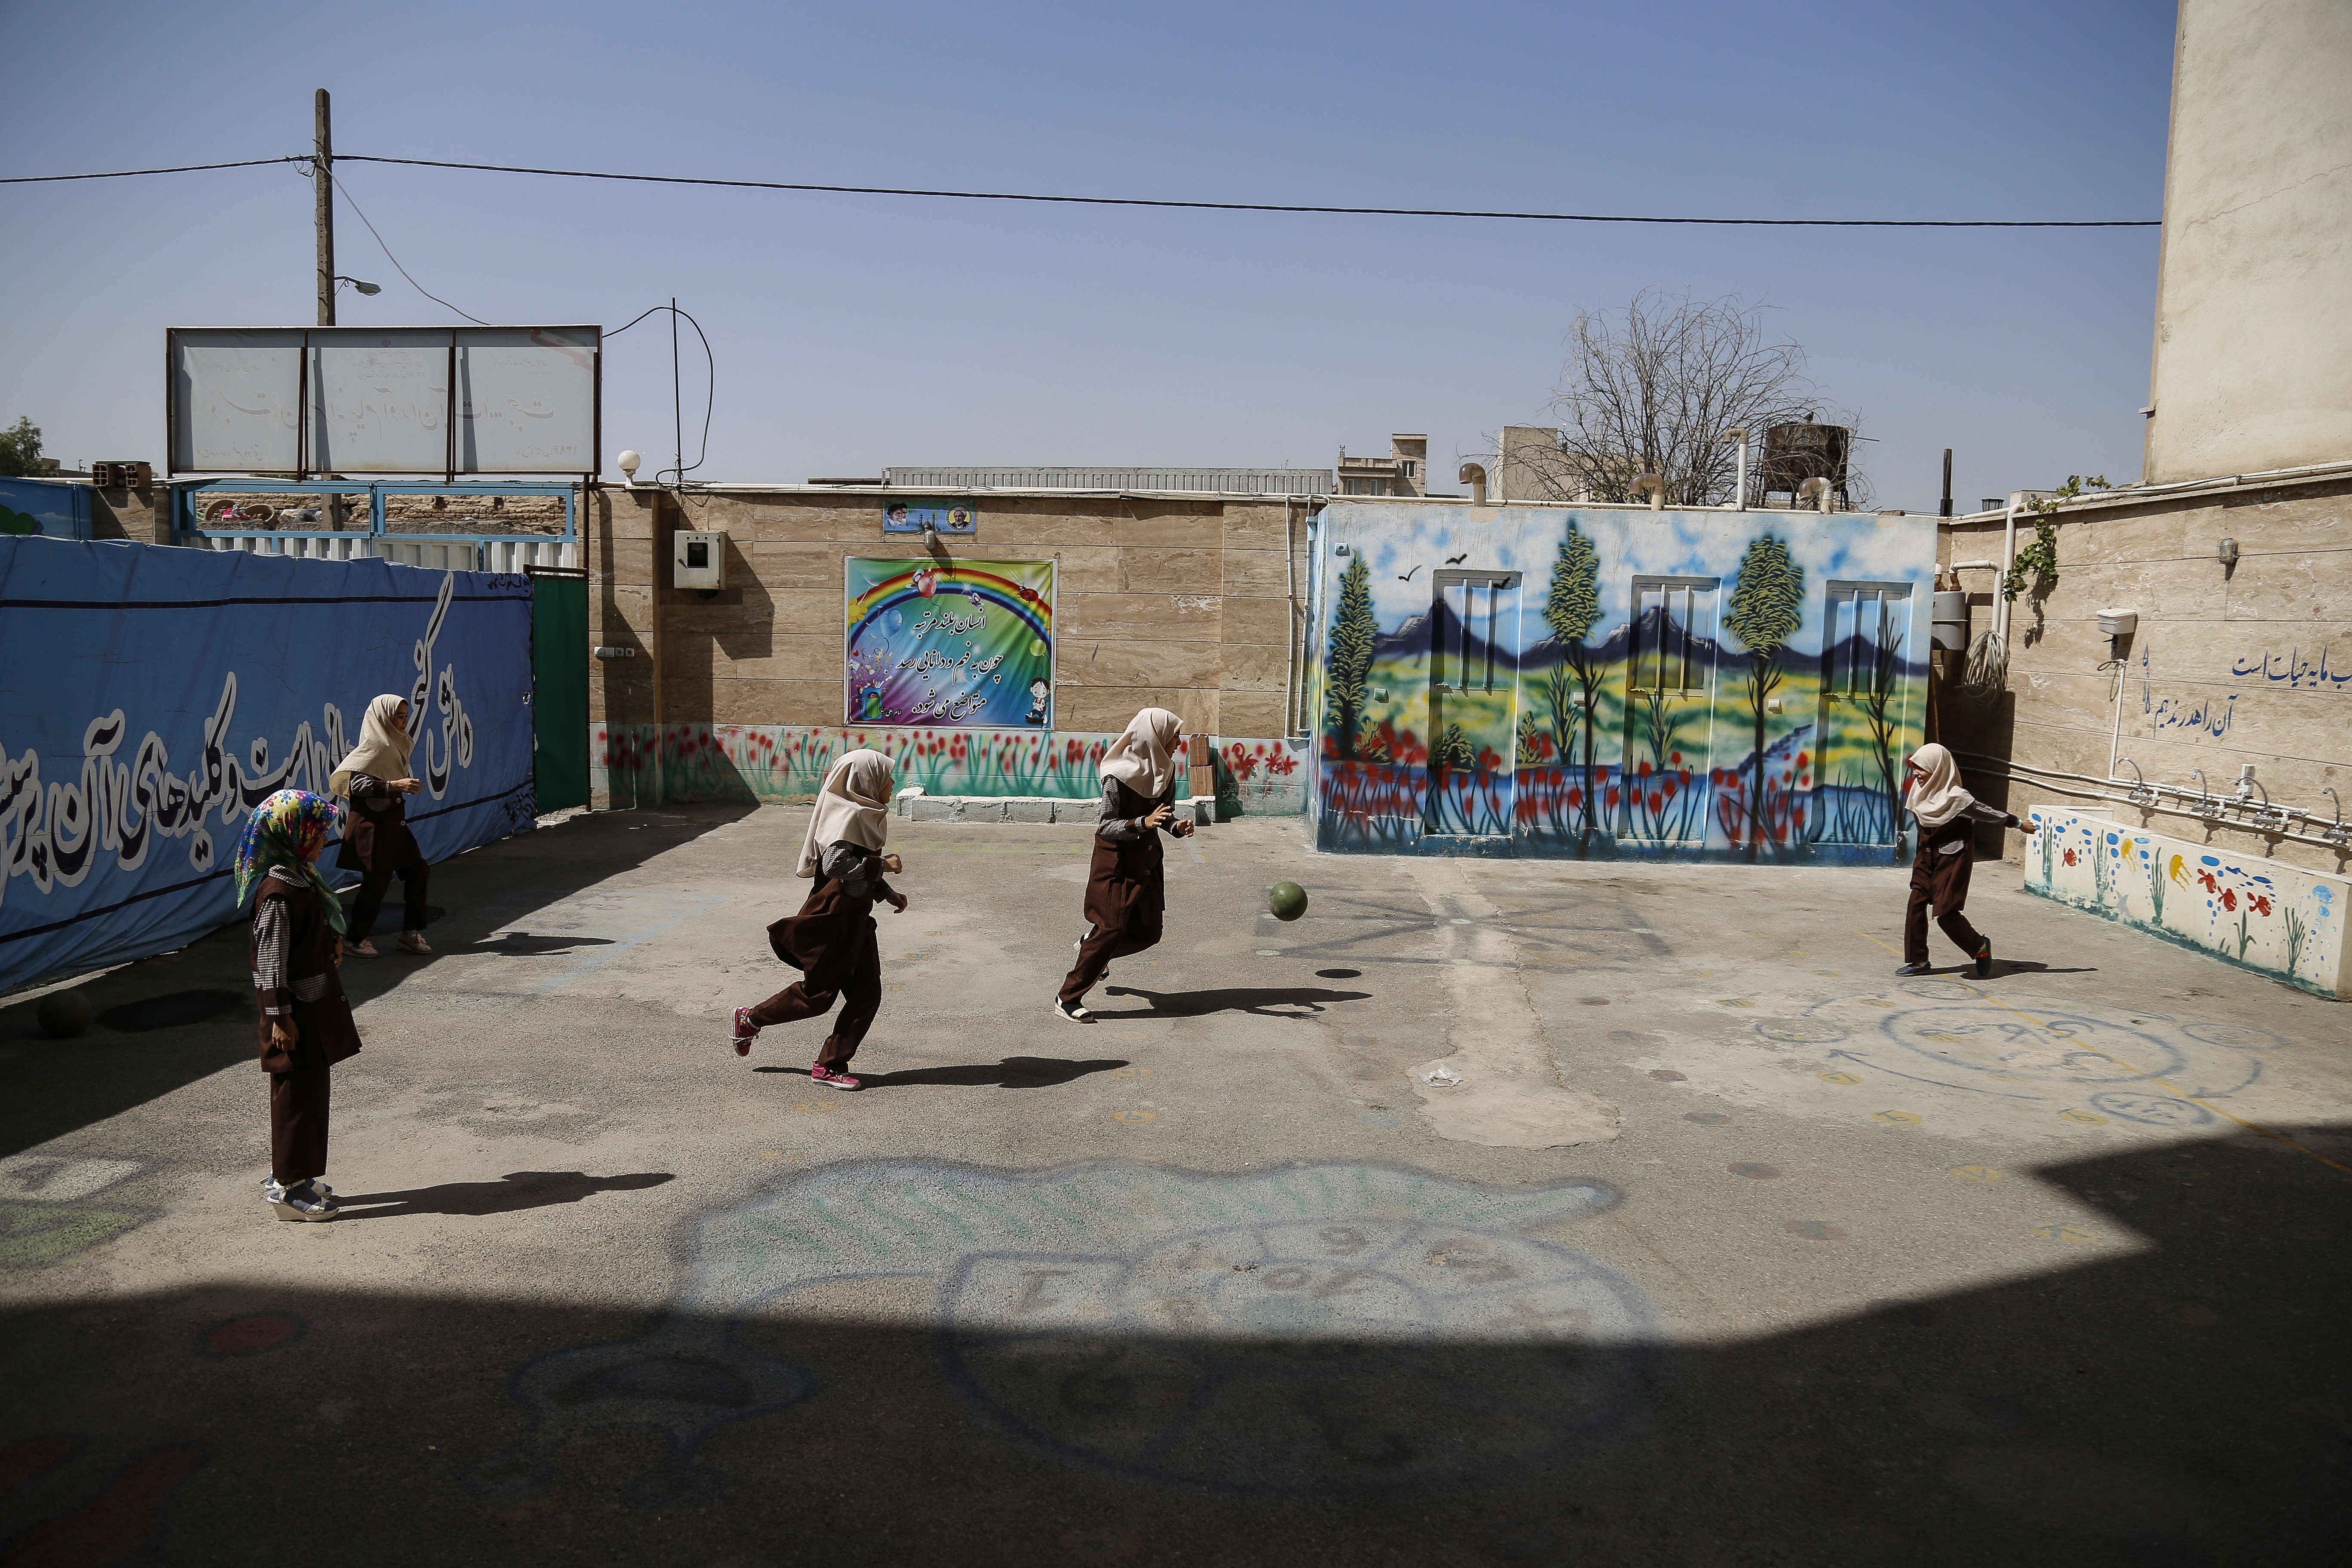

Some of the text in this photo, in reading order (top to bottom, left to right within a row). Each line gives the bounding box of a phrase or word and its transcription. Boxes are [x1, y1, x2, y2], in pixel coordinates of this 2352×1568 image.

[913, 608, 986, 639] انسان بلند مرتبه
[895, 640, 1004, 686] چون به فهم و دانایی رسد
[2232, 645, 2352, 690] ب مایه حیات است
[885, 707, 893, 717] علی
[892, 709, 902, 722] امام
[949, 690, 986, 721] متواضع
[2153, 693, 2239, 739] آن را هدر ندهیم
[426, 664, 473, 800] دانش
[45, 708, 126, 888] آن
